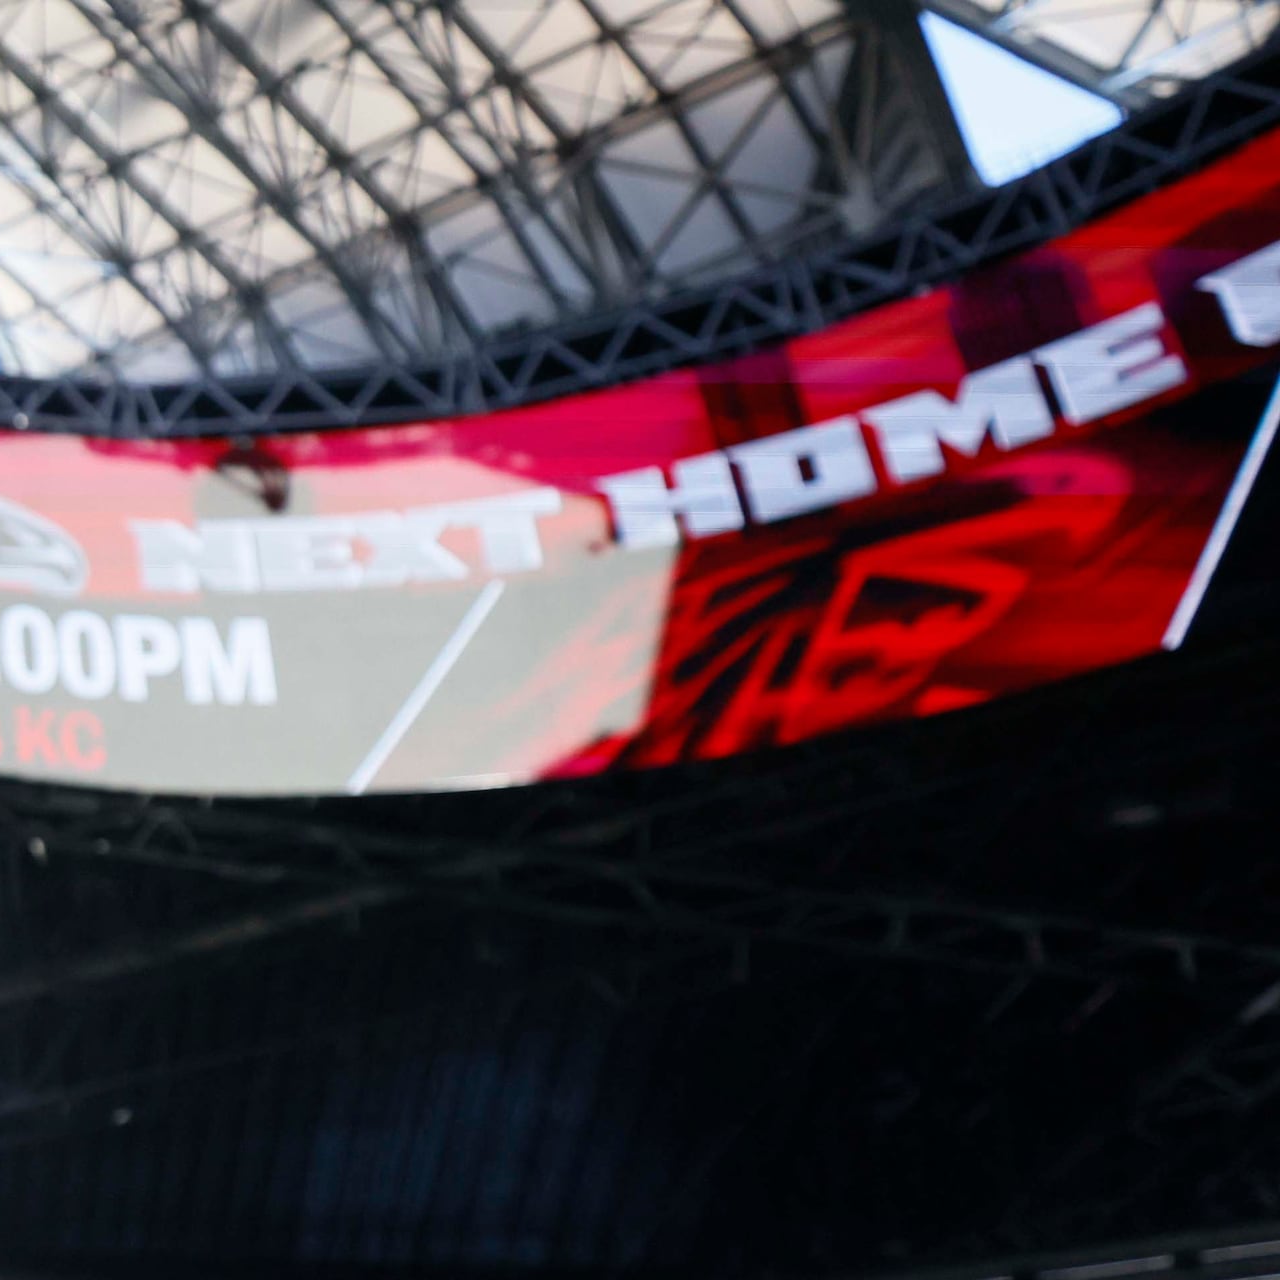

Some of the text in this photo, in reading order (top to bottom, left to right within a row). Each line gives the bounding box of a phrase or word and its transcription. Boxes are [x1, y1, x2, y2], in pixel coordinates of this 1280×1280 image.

[129, 301, 1187, 595] NEXT HOME
[14, 707, 107, 770] KC
